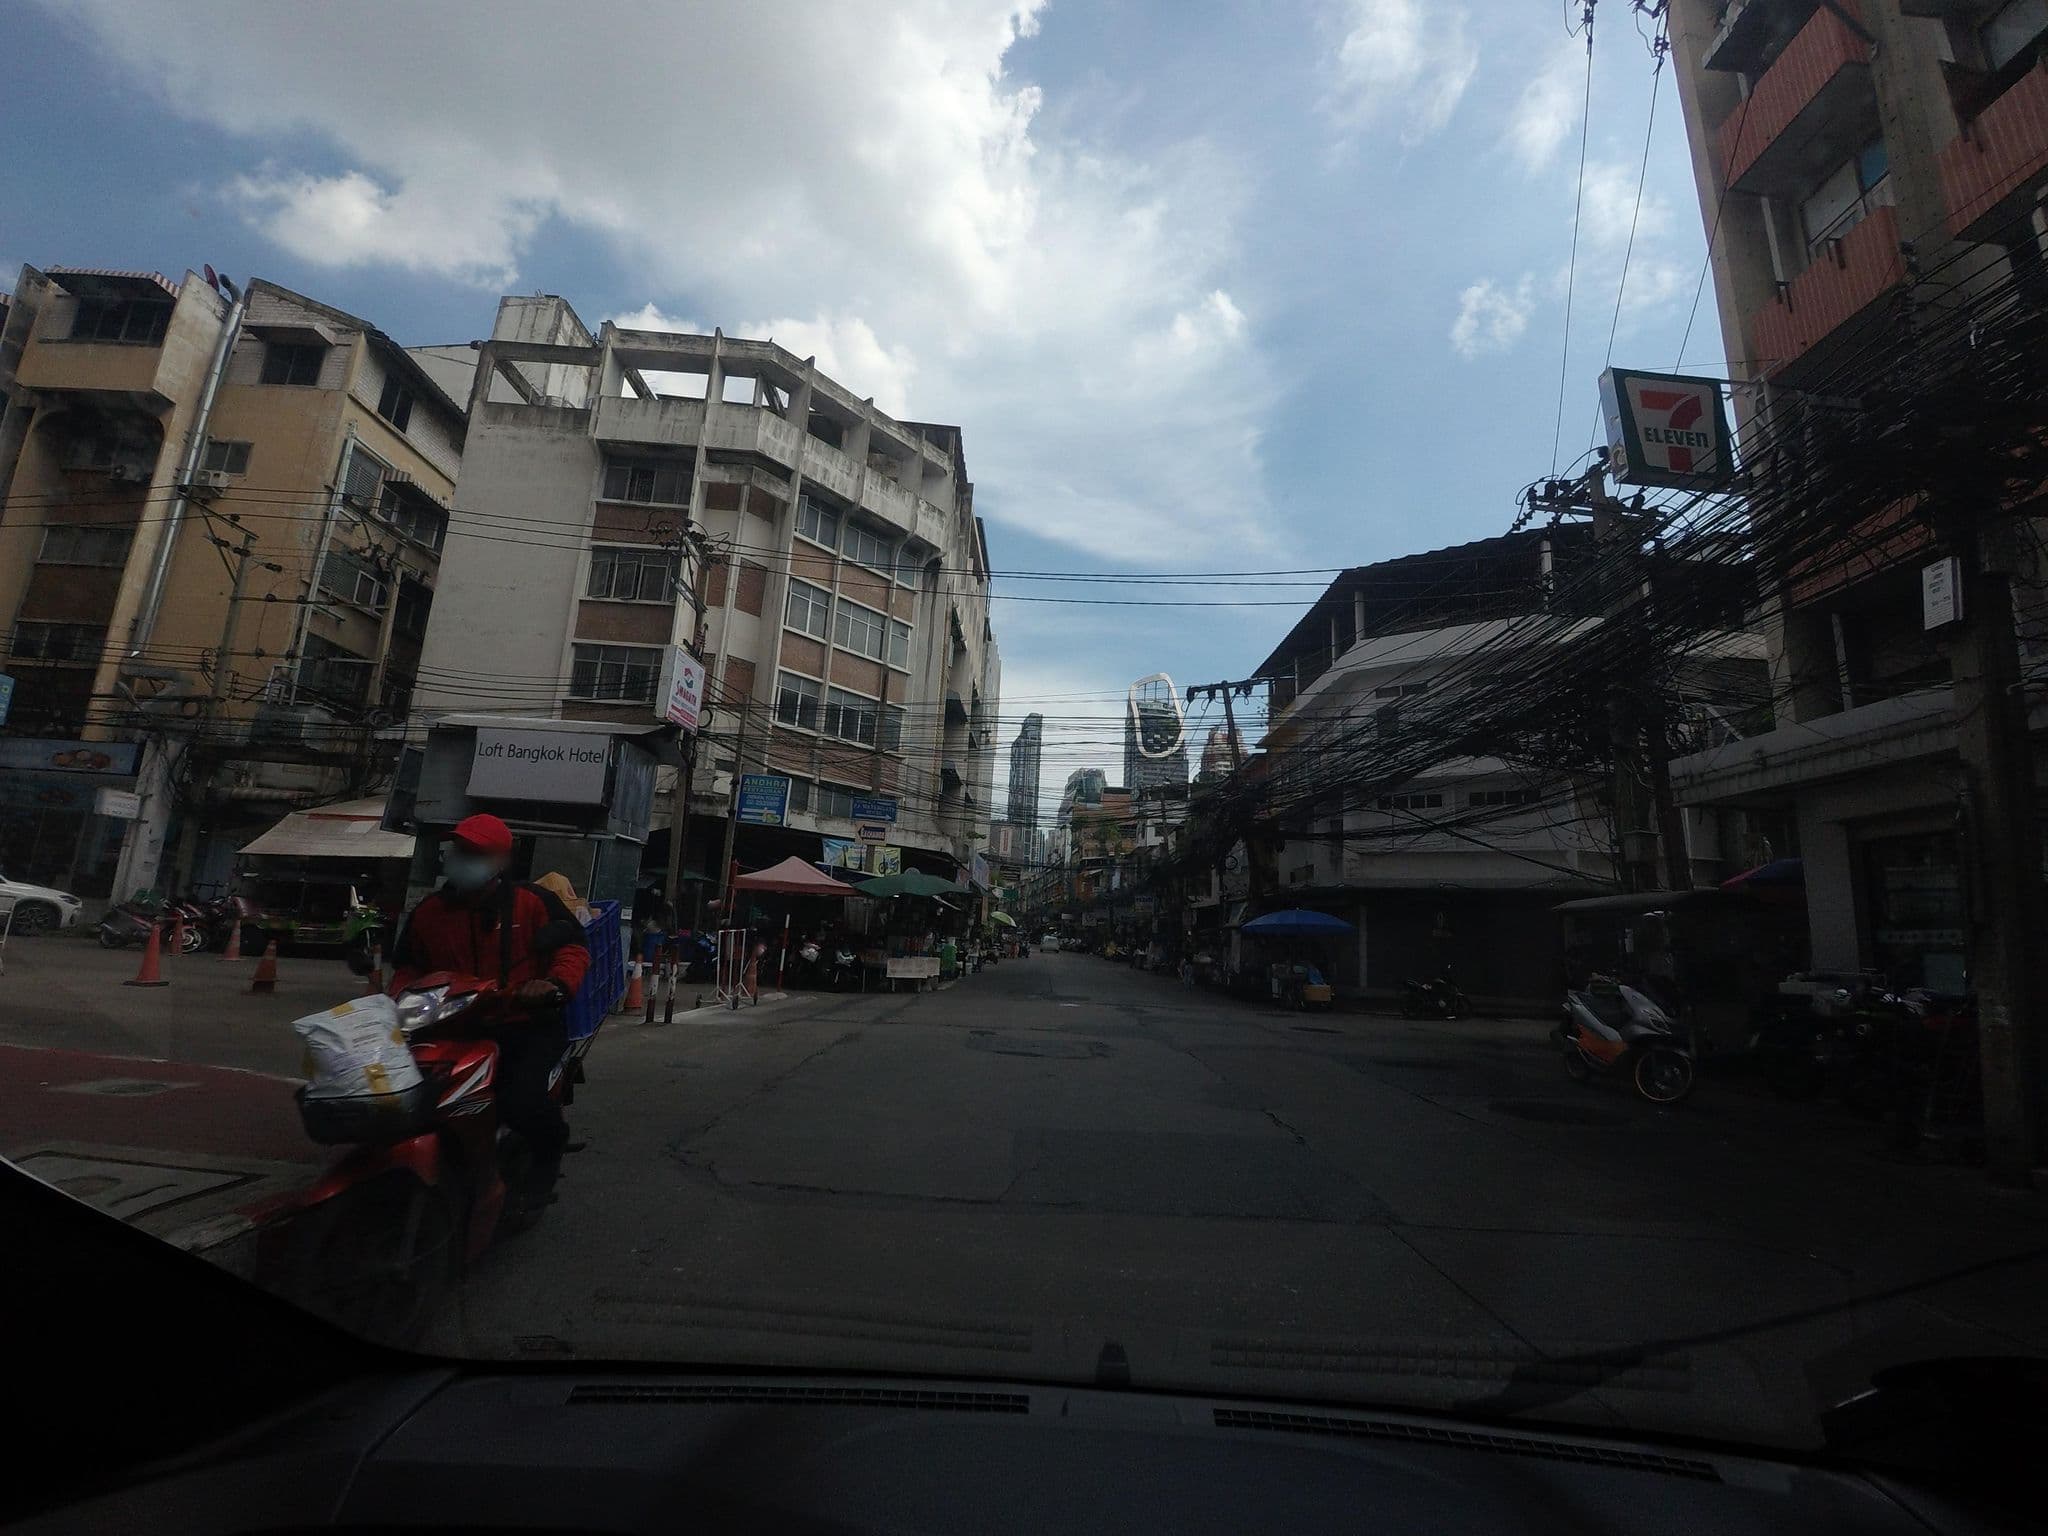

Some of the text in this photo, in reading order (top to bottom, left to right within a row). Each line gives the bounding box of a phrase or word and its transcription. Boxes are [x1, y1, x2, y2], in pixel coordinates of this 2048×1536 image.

[1639, 389, 1702, 473] 7
[478, 742, 605, 764] Loft Bangkok Hotel
[743, 778, 787, 789] ANDHRA
